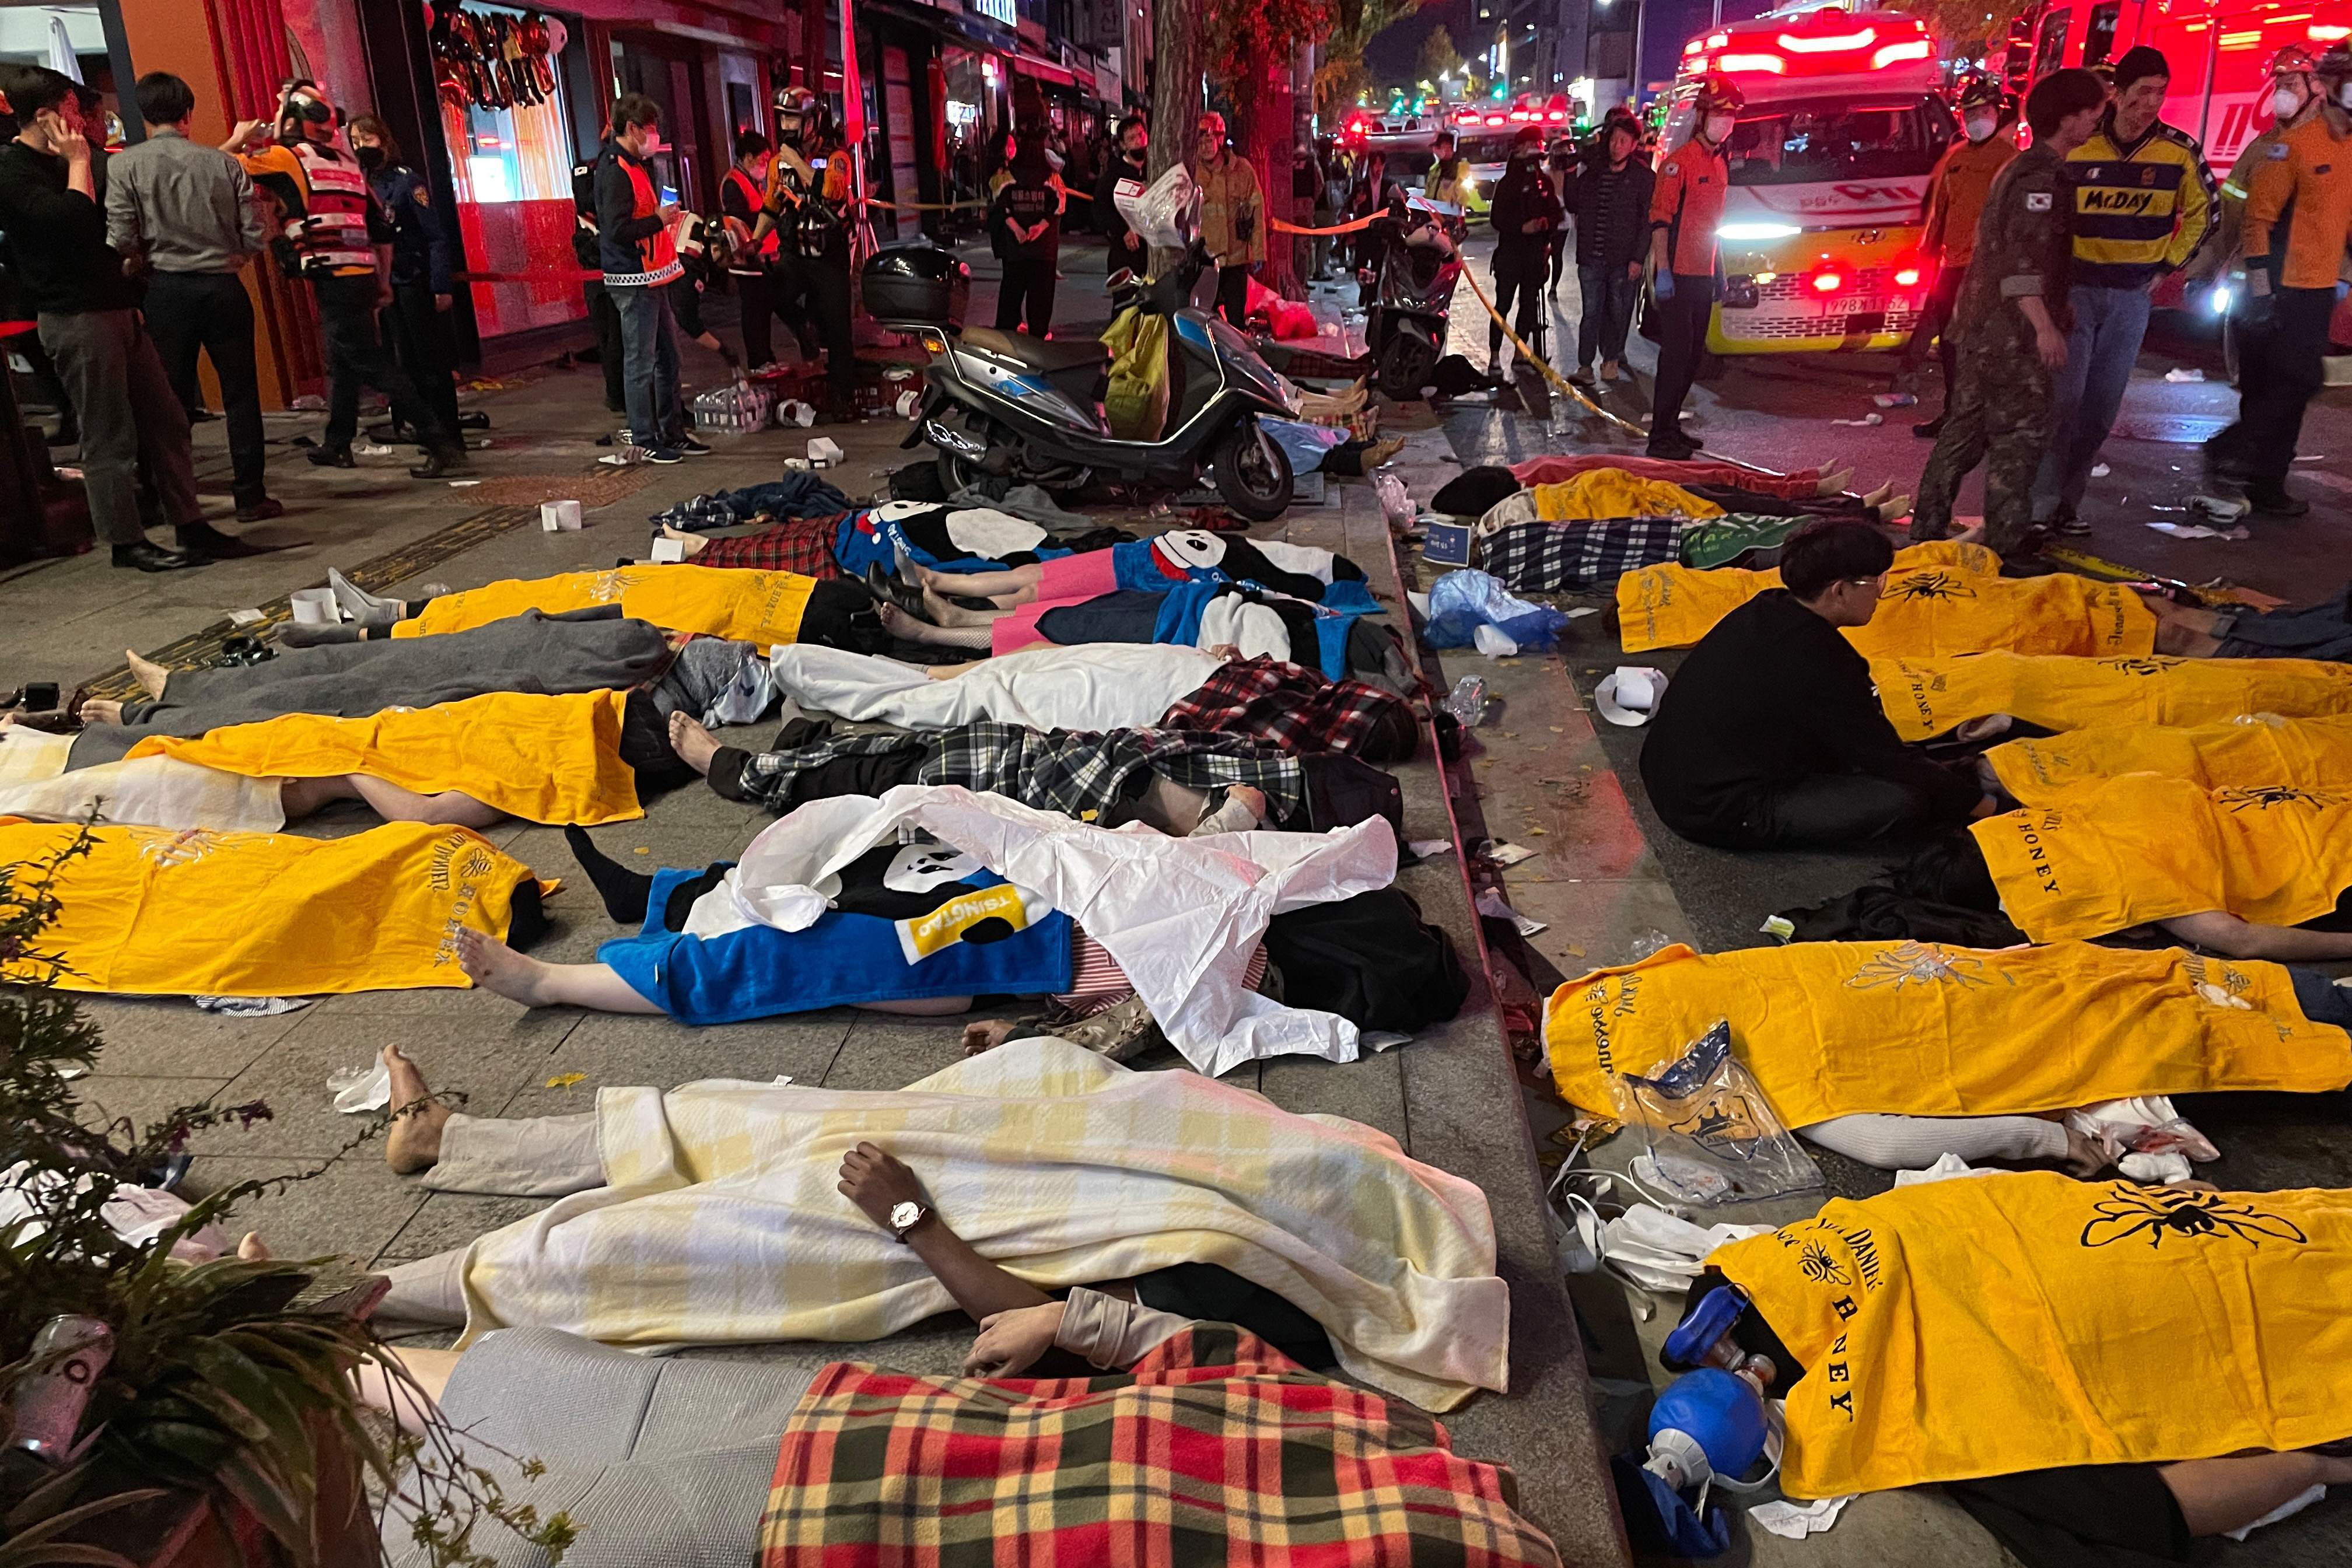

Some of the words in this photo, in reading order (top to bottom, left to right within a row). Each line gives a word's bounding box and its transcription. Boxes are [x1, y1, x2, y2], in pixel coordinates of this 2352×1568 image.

[2018, 822, 2062, 895] HONEY
[918, 895, 1012, 937] TSINGTAO
[1829, 1294, 1859, 1423] HNEY
